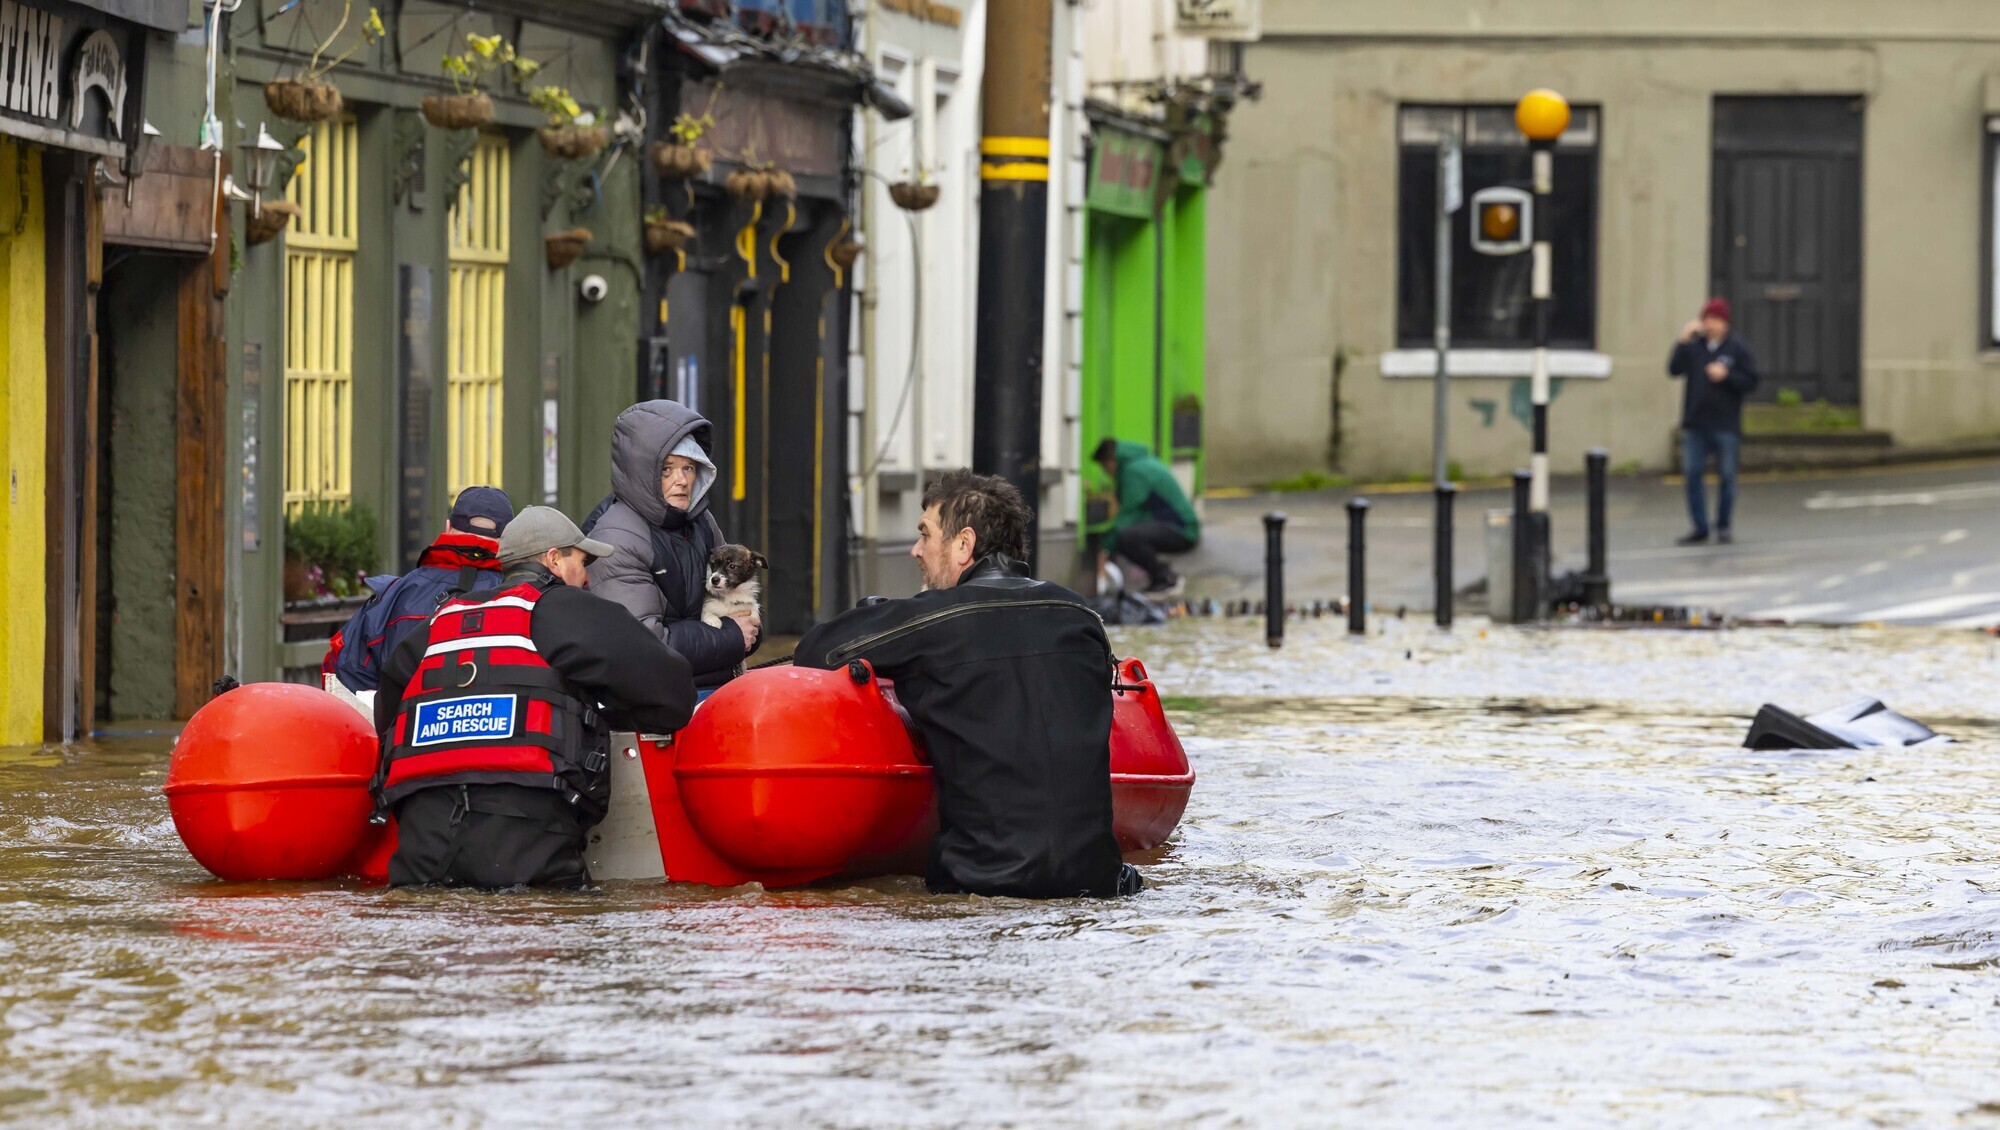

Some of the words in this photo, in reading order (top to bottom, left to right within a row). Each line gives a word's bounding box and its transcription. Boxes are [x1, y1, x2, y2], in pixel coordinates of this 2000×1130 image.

[437, 702, 492, 720] SEARCH
[420, 722, 448, 738] AND
[452, 717, 507, 733] RESCUE
